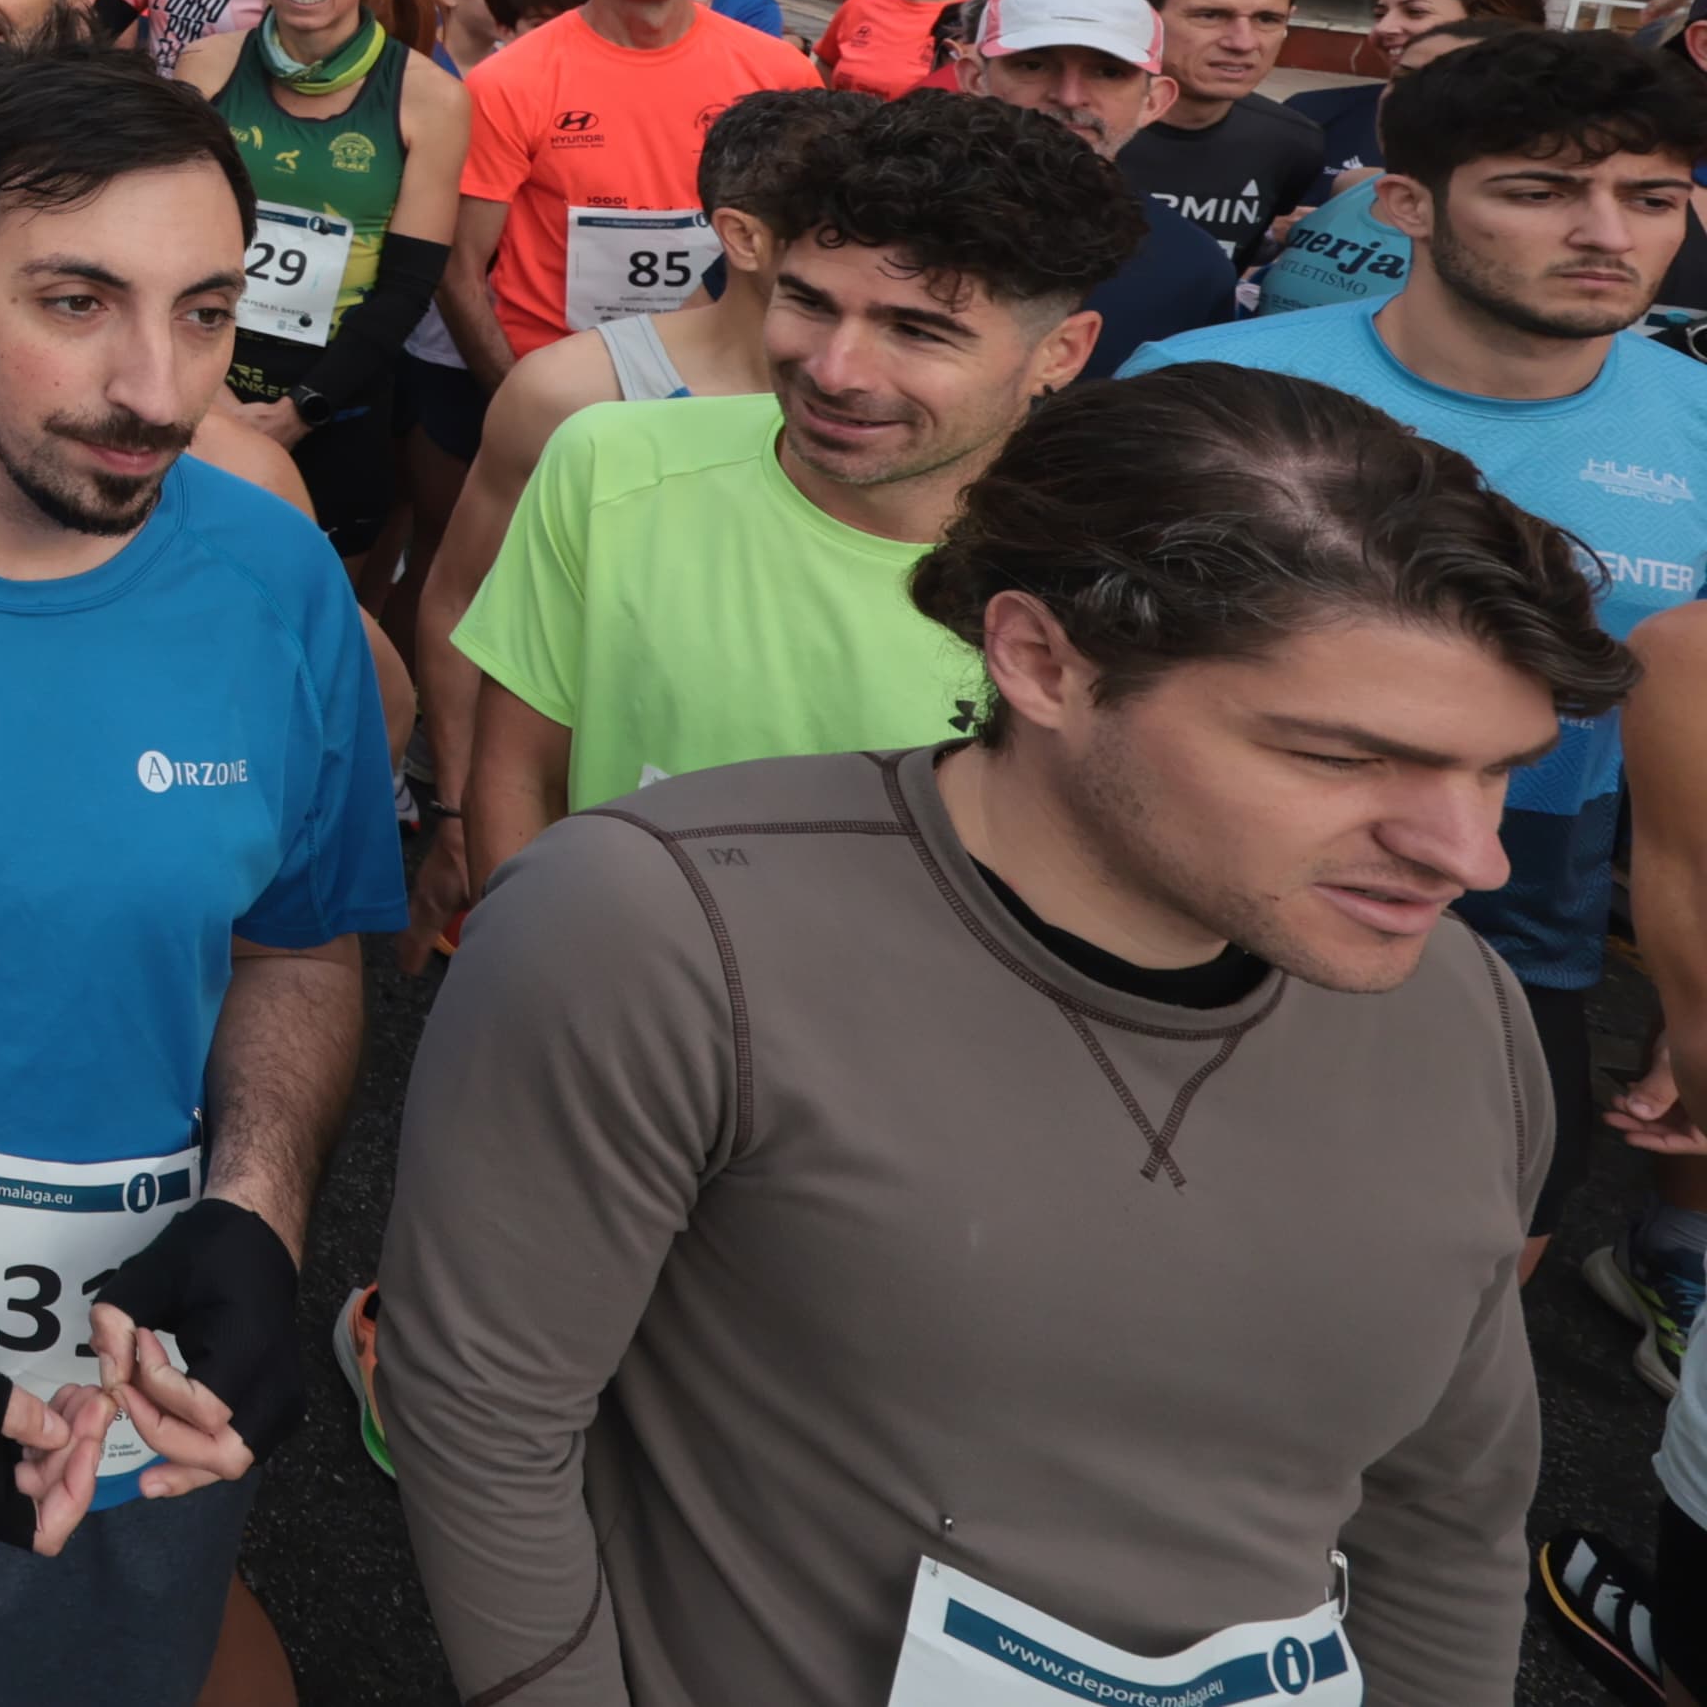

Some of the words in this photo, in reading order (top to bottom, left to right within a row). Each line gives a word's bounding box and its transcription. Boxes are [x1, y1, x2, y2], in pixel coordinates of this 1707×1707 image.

[550, 133, 605, 144] HYUNDAI
[1151, 192, 1260, 225] MIN
[627, 250, 692, 288] 85
[1291, 227, 1405, 280] nerja
[139, 751, 248, 793] AIRZONE
[997, 1633, 1225, 1707] www.deporte.malaga.eu
